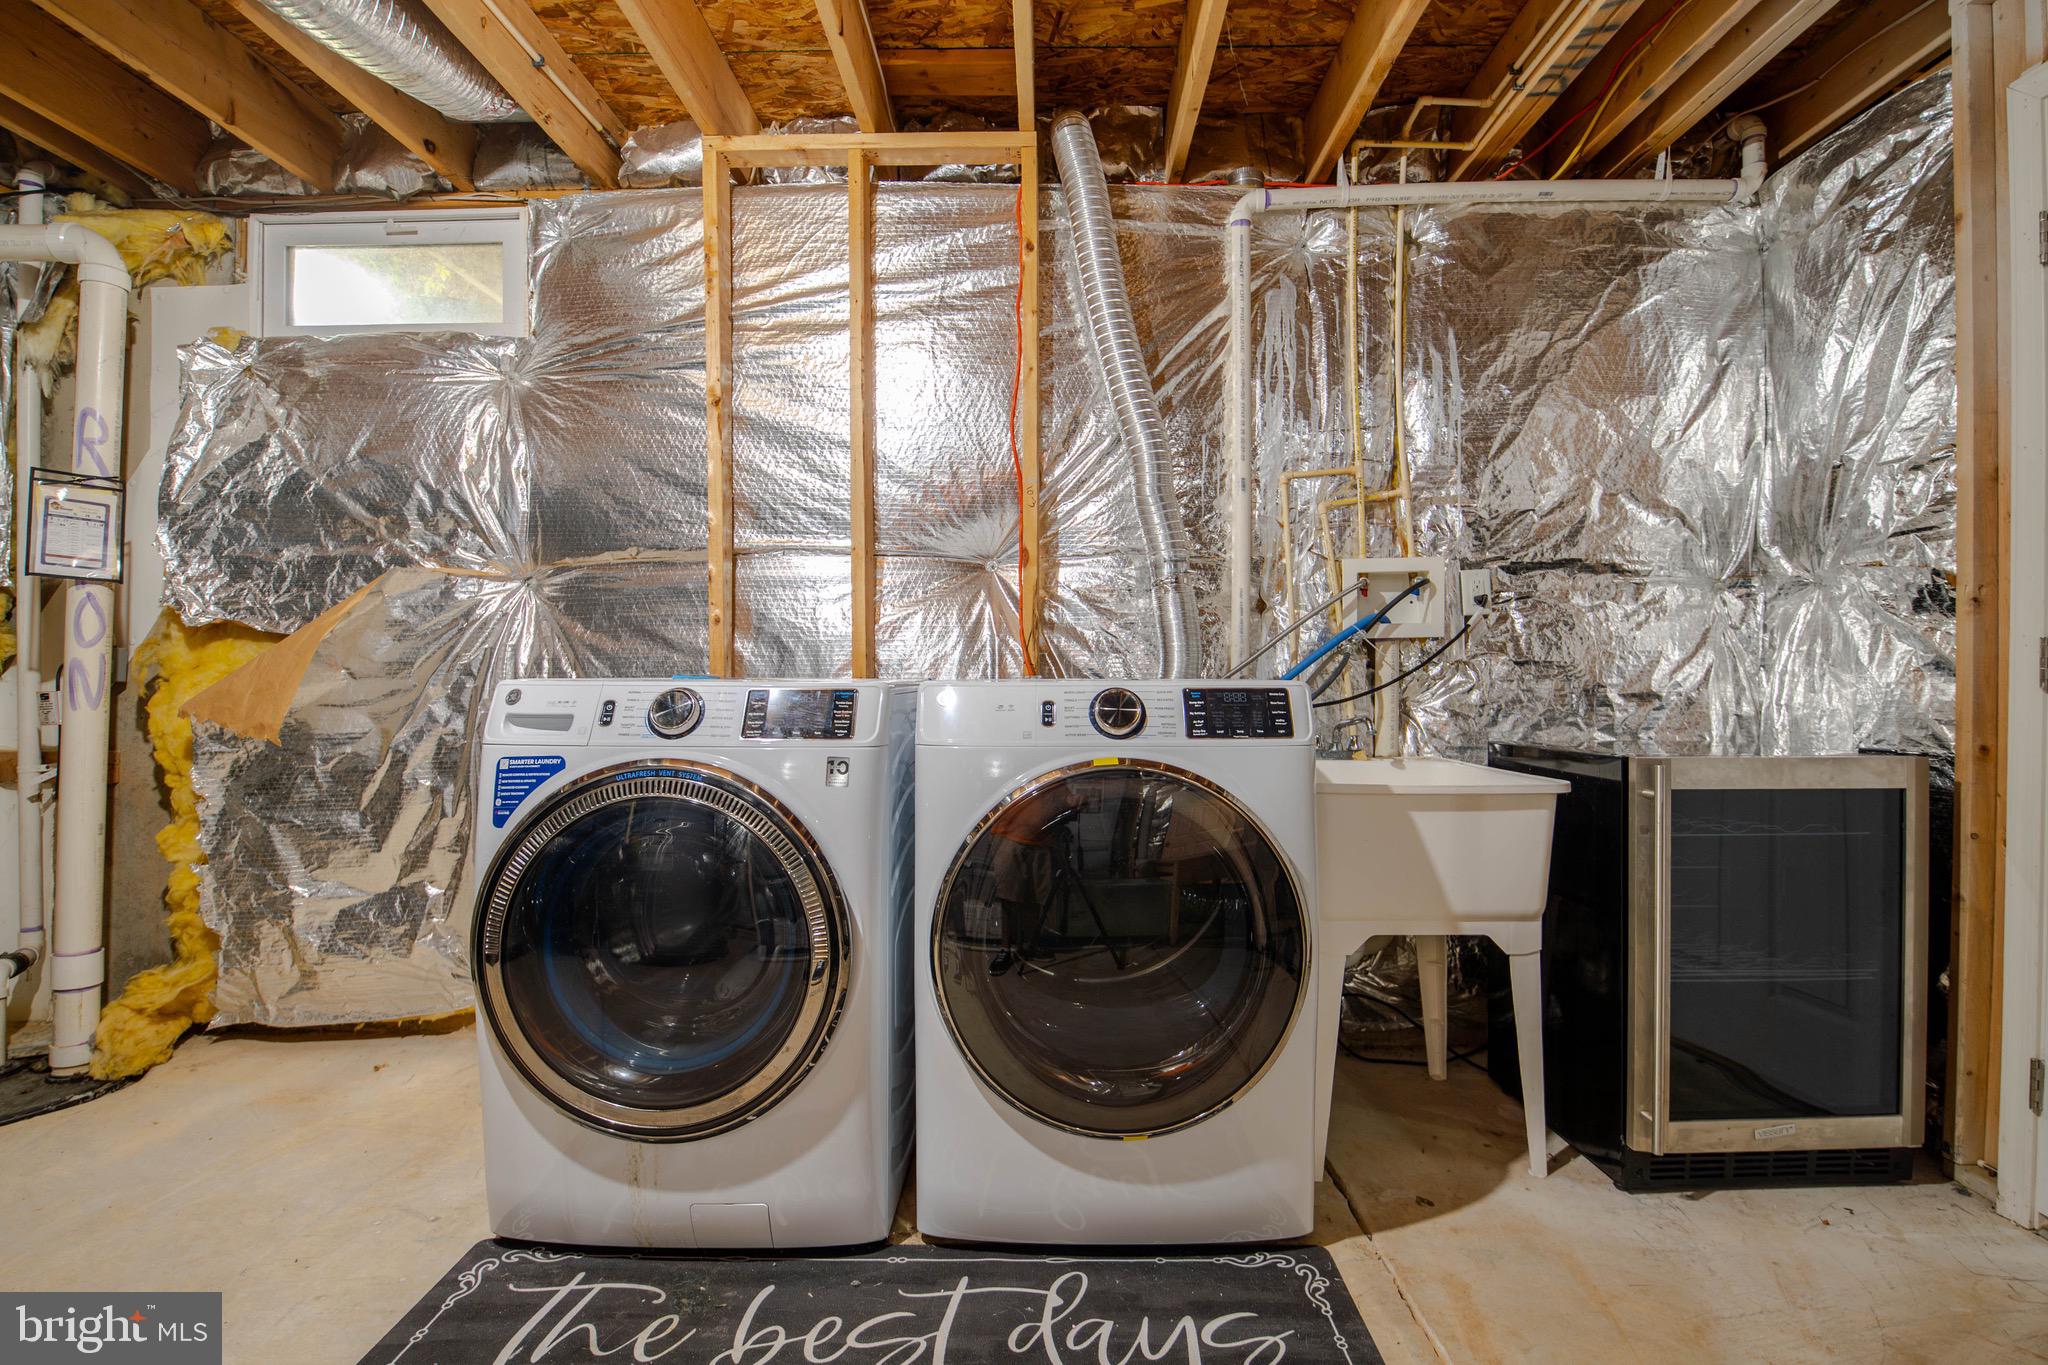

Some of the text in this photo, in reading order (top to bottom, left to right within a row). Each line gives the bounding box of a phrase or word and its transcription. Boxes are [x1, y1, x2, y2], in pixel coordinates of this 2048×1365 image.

[615, 769, 704, 782] ULTRAFRESH VENT SYSTEM
[473, 1271, 1295, 1365] The best days
